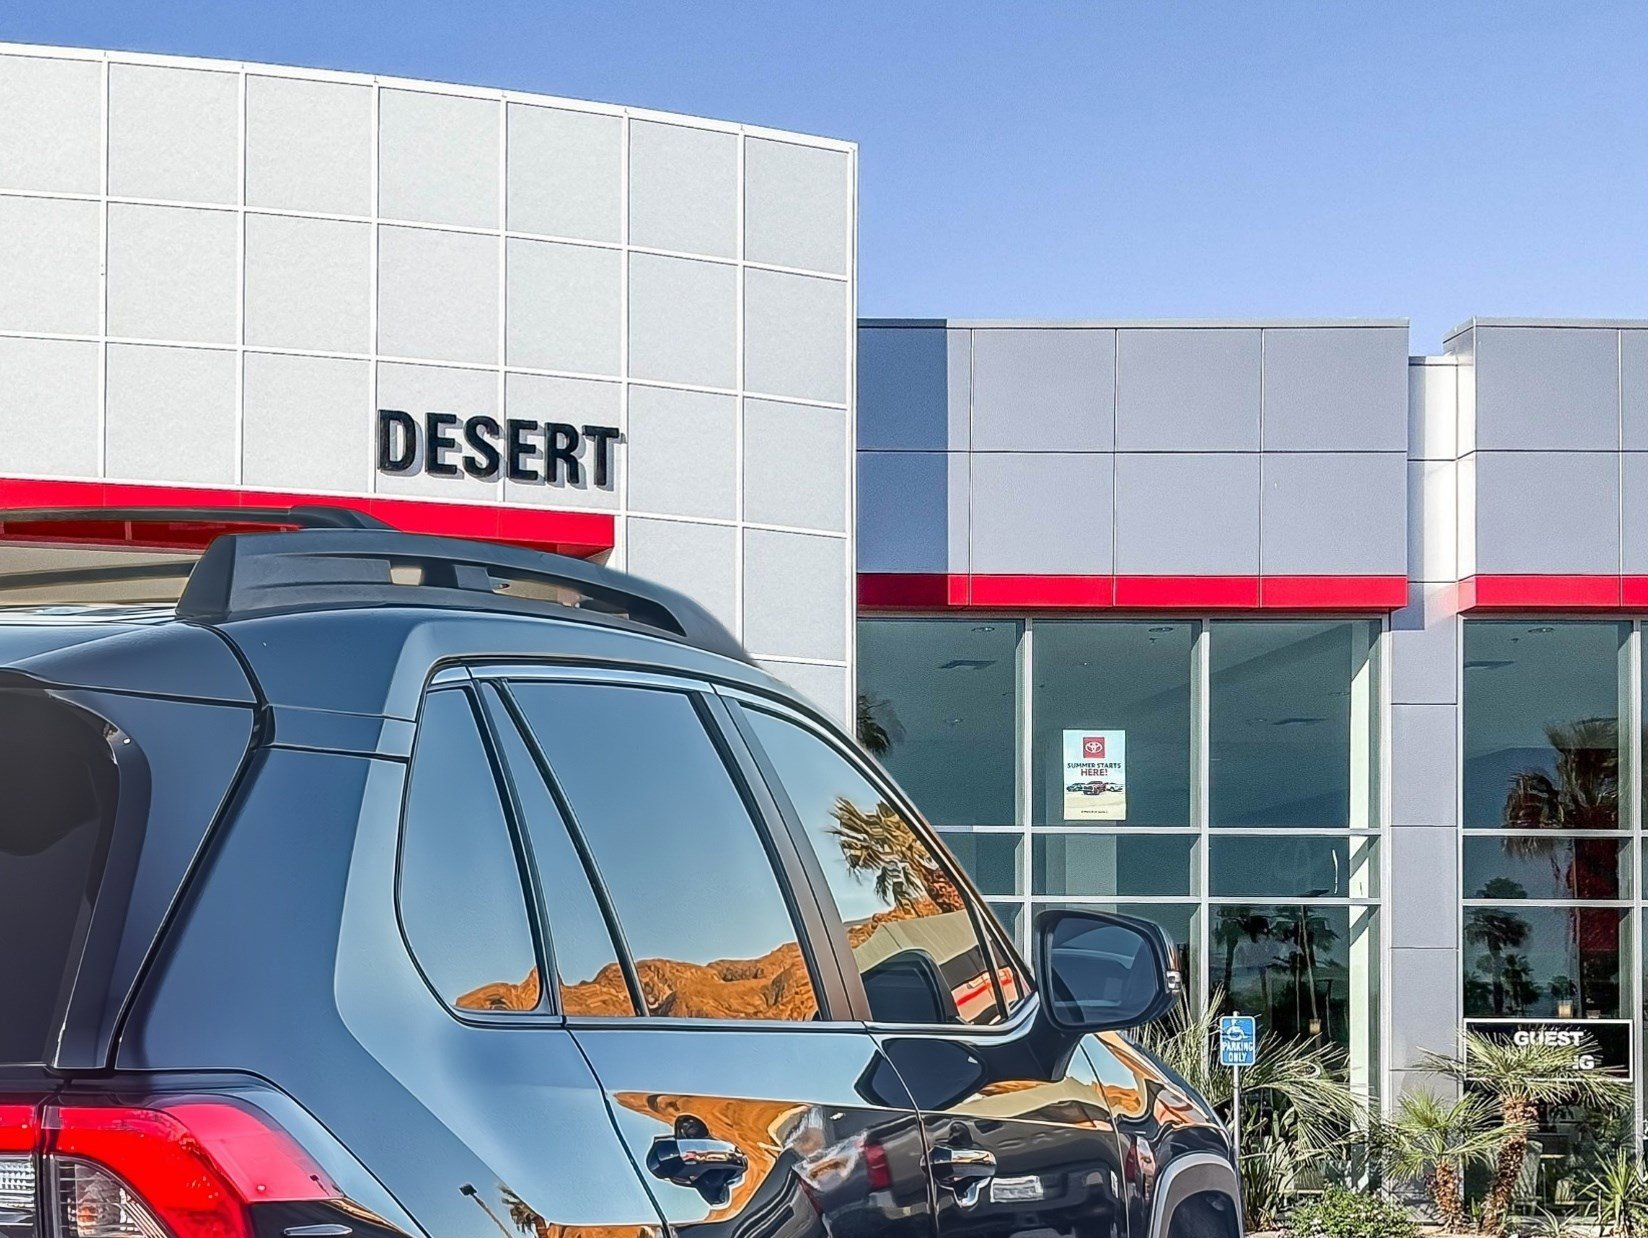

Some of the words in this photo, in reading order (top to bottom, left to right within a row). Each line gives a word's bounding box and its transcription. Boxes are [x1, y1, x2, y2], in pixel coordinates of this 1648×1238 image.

[377, 409, 620, 487] DESERT
[1081, 768, 1108, 776] HERE!
[1514, 1030, 1584, 1046] GUEST
[1222, 1041, 1254, 1051] PARKING
[1228, 1052, 1247, 1062] ONLY
